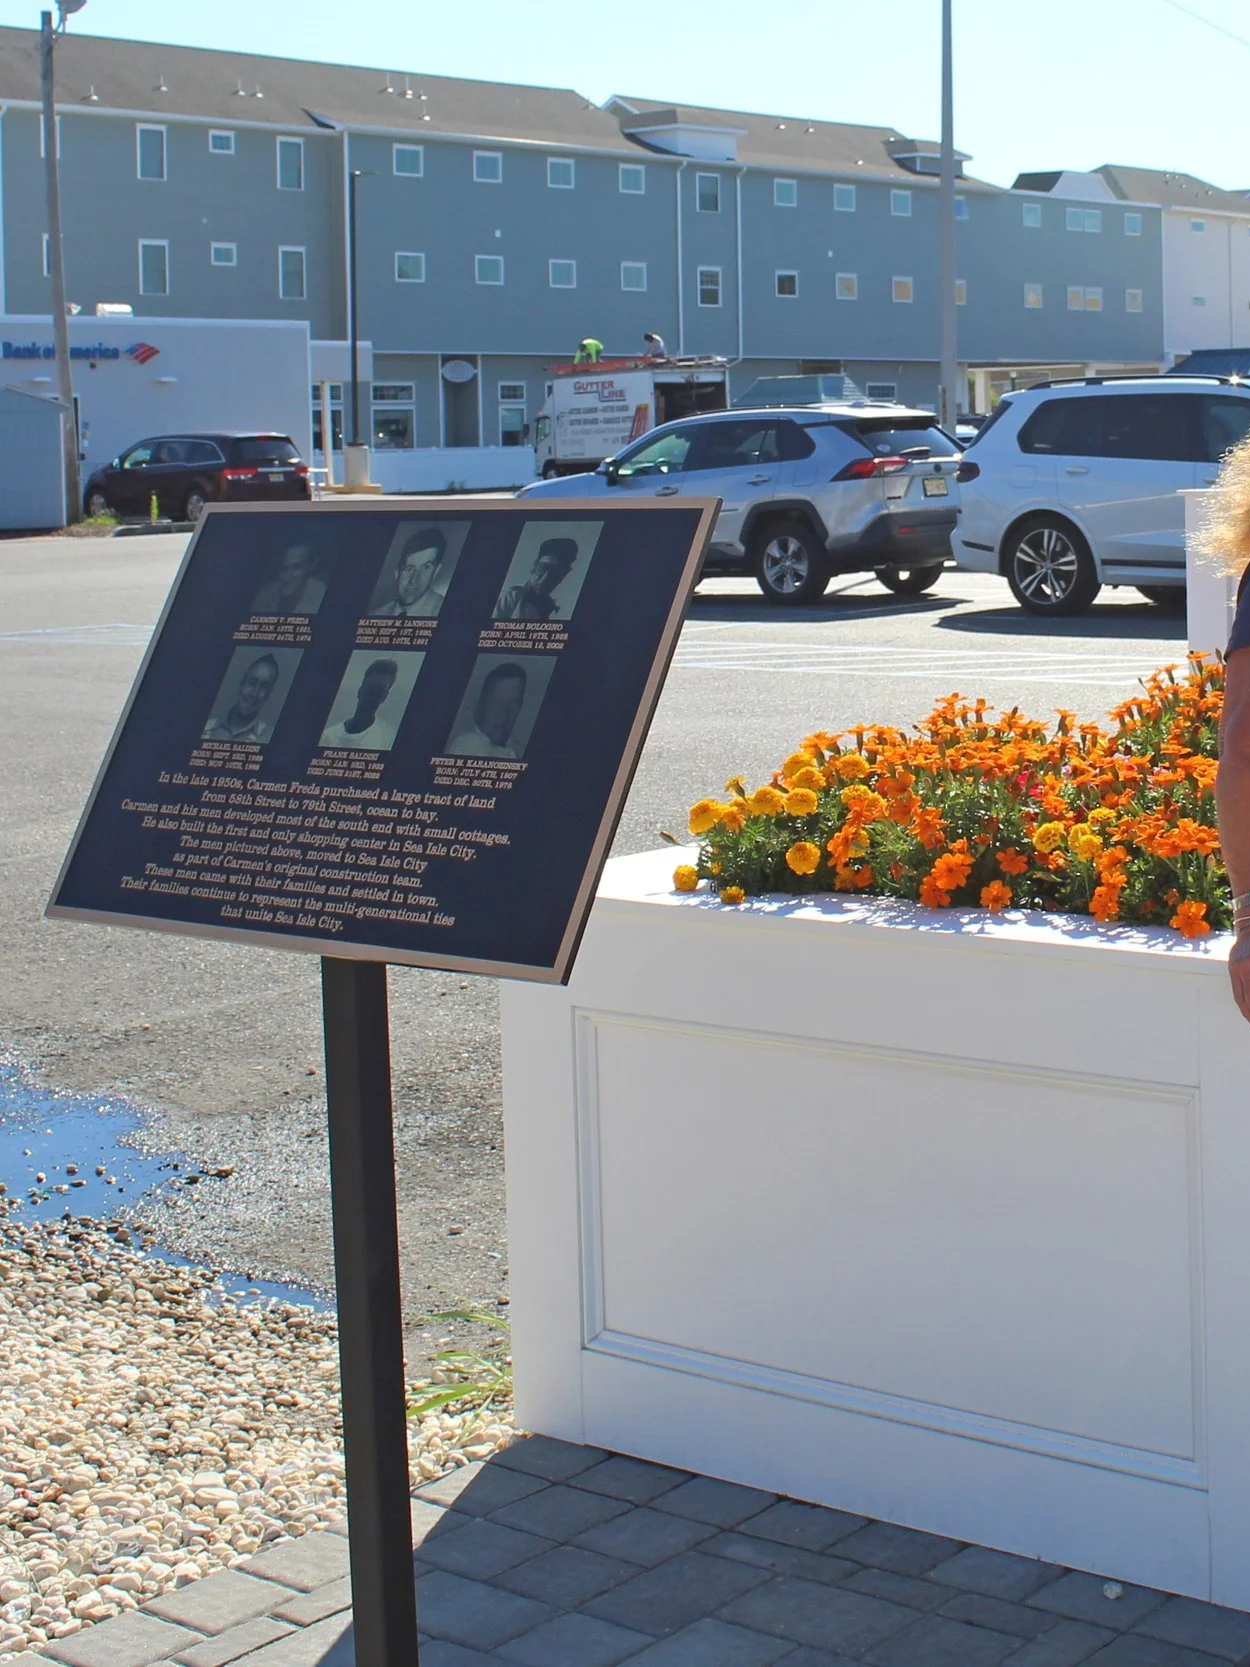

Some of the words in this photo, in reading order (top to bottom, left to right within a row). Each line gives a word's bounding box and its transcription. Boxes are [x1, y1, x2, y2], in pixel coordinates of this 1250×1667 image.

[2, 341, 41, 359] Bank
[69, 342, 119, 359] merica
[574, 380, 614, 391] GUTTER
[601, 389, 625, 399] LINE
[403, 620, 438, 628] IANNONE
[493, 622, 525, 630] THOMAS
[525, 623, 563, 631] BOLOGNO
[498, 640, 533, 648] OCTOBER
[504, 631, 527, 639] APRIL
[323, 750, 349, 758] FRANK
[430, 757, 455, 766] PETER
[435, 767, 458, 775] BORN:
[158, 771, 170, 782] In
[172, 773, 188, 784] the
[190, 774, 209, 785] late
[211, 777, 243, 790] 1950s,
[247, 778, 287, 792] Carmen
[289, 782, 320, 795] Freda
[320, 786, 380, 799] purchased
[381, 791, 388, 800] a
[391, 789, 421, 805] large
[424, 793, 452, 805] tract
[454, 795, 468, 806] of
[468, 795, 496, 809] land
[201, 790, 226, 803] from
[254, 795, 286, 808] Street
[288, 798, 299, 809] to
[302, 800, 326, 811] 79th
[328, 801, 363, 816] Street,
[366, 807, 398, 817] ocean
[402, 807, 413, 819] to
[415, 808, 438, 823] bay.
[122, 799, 158, 812] Carmen
[160, 803, 181, 814] and
[181, 804, 198, 816] his
[199, 808, 221, 818] men
[224, 808, 275, 824] developed
[276, 815, 303, 826] most
[304, 816, 318, 827] of
[318, 817, 336, 829] the
[337, 820, 369, 831] south
[372, 822, 394, 834] end
[396, 824, 421, 836] with
[423, 827, 457, 839] small
[458, 830, 510, 846] cottages.
[141, 816, 156, 827] He
[158, 818, 179, 829] also
[180, 819, 205, 832] built
[206, 822, 223, 834] the
[224, 824, 248, 836] first
[249, 828, 271, 839] and
[272, 829, 296, 844] only
[297, 831, 349, 849] shopping
[351, 838, 387, 850] center
[388, 839, 400, 851] in
[402, 840, 423, 853] Sea
[425, 842, 447, 856] Isle
[450, 845, 476, 861] City.
[180, 835, 199, 847] The
[200, 840, 223, 850] men
[223, 841, 270, 855] pictured
[270, 845, 303, 860] above,
[306, 850, 343, 862] moved
[344, 852, 356, 863] to
[357, 852, 377, 866] Sea
[379, 855, 401, 868] Isle
[403, 857, 428, 873] City
[173, 853, 186, 862] as
[185, 855, 209, 866] part
[211, 855, 224, 866] of
[224, 856, 272, 871] Carmen's
[274, 862, 318, 877] original
[319, 868, 389, 884] construction
[392, 873, 423, 888] team.
[145, 863, 174, 876] These
[175, 869, 197, 879] men
[200, 872, 226, 883] came
[229, 873, 252, 885] with
[255, 876, 282, 889] their
[282, 878, 326, 894] families
[328, 885, 350, 896] and
[351, 887, 390, 901] settled
[391, 890, 404, 903] in
[407, 892, 439, 907] town.
[120, 876, 148, 889] Their
[149, 880, 190, 895] families
[191, 887, 236, 900] continue
[238, 891, 249, 902] to
[250, 894, 302, 908] represent
[304, 898, 322, 910] the
[324, 902, 431, 923] multi-generational
[433, 913, 455, 926] ties
[221, 904, 243, 918] that
[245, 909, 273, 922] unite
[274, 911, 294, 924] Sea
[295, 913, 316, 927] Isle
[318, 916, 343, 932] City.
